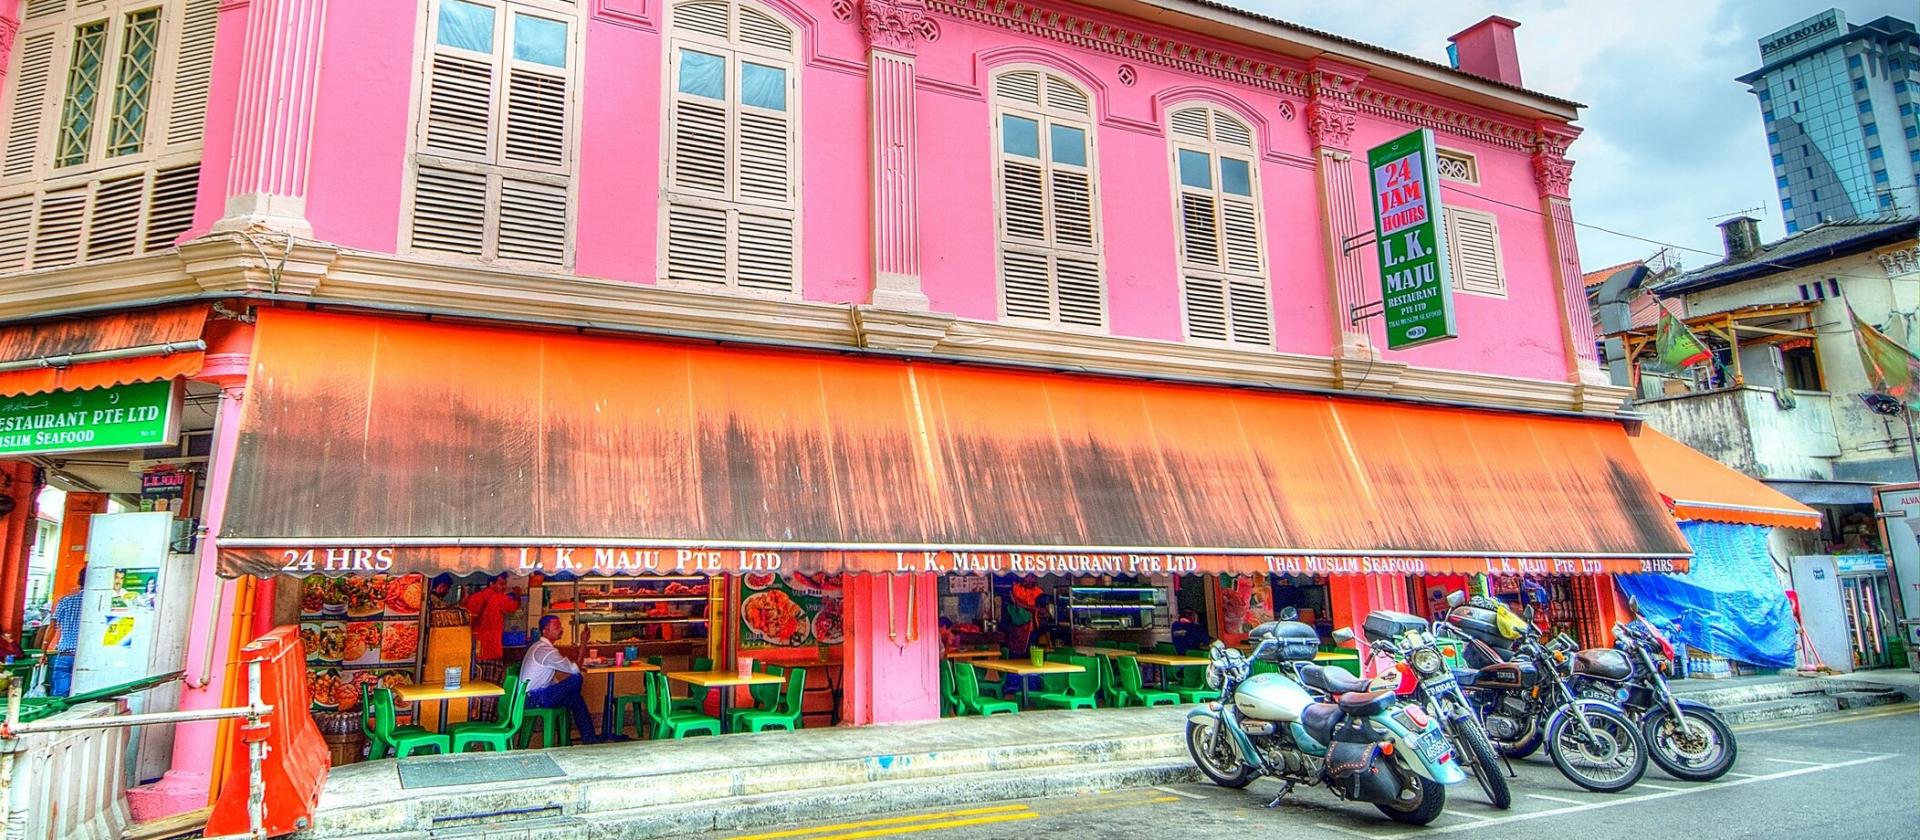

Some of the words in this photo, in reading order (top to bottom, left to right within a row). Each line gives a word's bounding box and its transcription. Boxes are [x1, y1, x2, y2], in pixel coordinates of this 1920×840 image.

[1762, 17, 1836, 53] PARKROYAL
[1386, 157, 1411, 187] 24
[1381, 180, 1422, 214] JAM
[1383, 205, 1425, 232] HOURS
[1385, 262, 1434, 293] MAJU
[1388, 287, 1437, 308] RESTAURANT
[1401, 306, 1414, 315] PTE
[1415, 303, 1427, 311] LTD
[92, 408, 124, 424] PTE
[127, 406, 159, 422] LTD
[35, 430, 94, 445] SEAFOOD
[282, 550, 316, 571] 24
[324, 549, 394, 571] HRS
[519, 548, 543, 569] L.
[555, 548, 582, 569] K.
[594, 548, 659, 569] MAJU
[677, 549, 722, 569] PTE
[739, 550, 782, 570] LTD
[896, 551, 915, 571] L.
[924, 552, 945, 571] K.
[952, 552, 1002, 571] MAJU
[1010, 552, 1122, 571] RESTAURANT
[1129, 554, 1160, 571] PTE
[1166, 554, 1197, 571] LTD
[1264, 555, 1301, 571] THAI
[1304, 555, 1359, 572] MUSLIM
[1362, 556, 1425, 572] SEAFOOD
[1485, 558, 1498, 572] L.
[1501, 558, 1514, 572] K.
[1518, 558, 1547, 572] MAJU
[1553, 559, 1575, 572] PTE
[1581, 559, 1601, 572] LTD
[1640, 560, 1651, 572] 24
[1653, 559, 1673, 572] HRS
[1424, 732, 1437, 746] FZ
